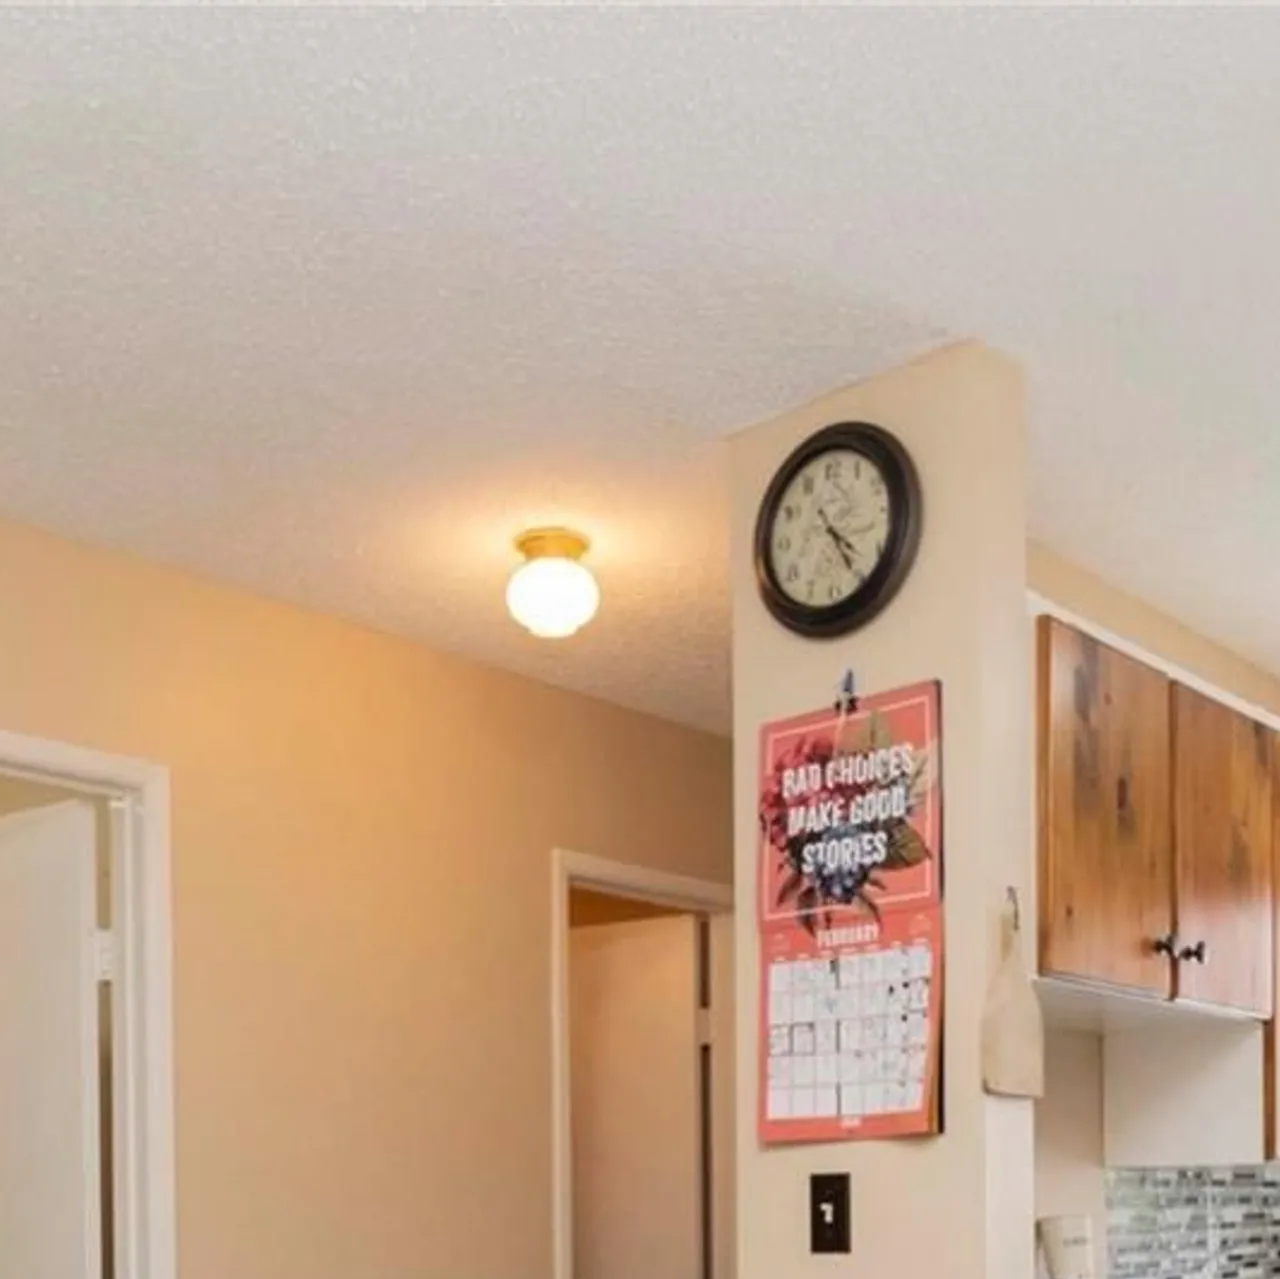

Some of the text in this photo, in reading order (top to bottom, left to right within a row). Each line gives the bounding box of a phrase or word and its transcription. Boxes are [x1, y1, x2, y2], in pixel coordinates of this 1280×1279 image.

[782, 743, 914, 799] BAD CHOICES
[787, 785, 907, 837] MAKE GOOD
[802, 831, 889, 874] STORIES
